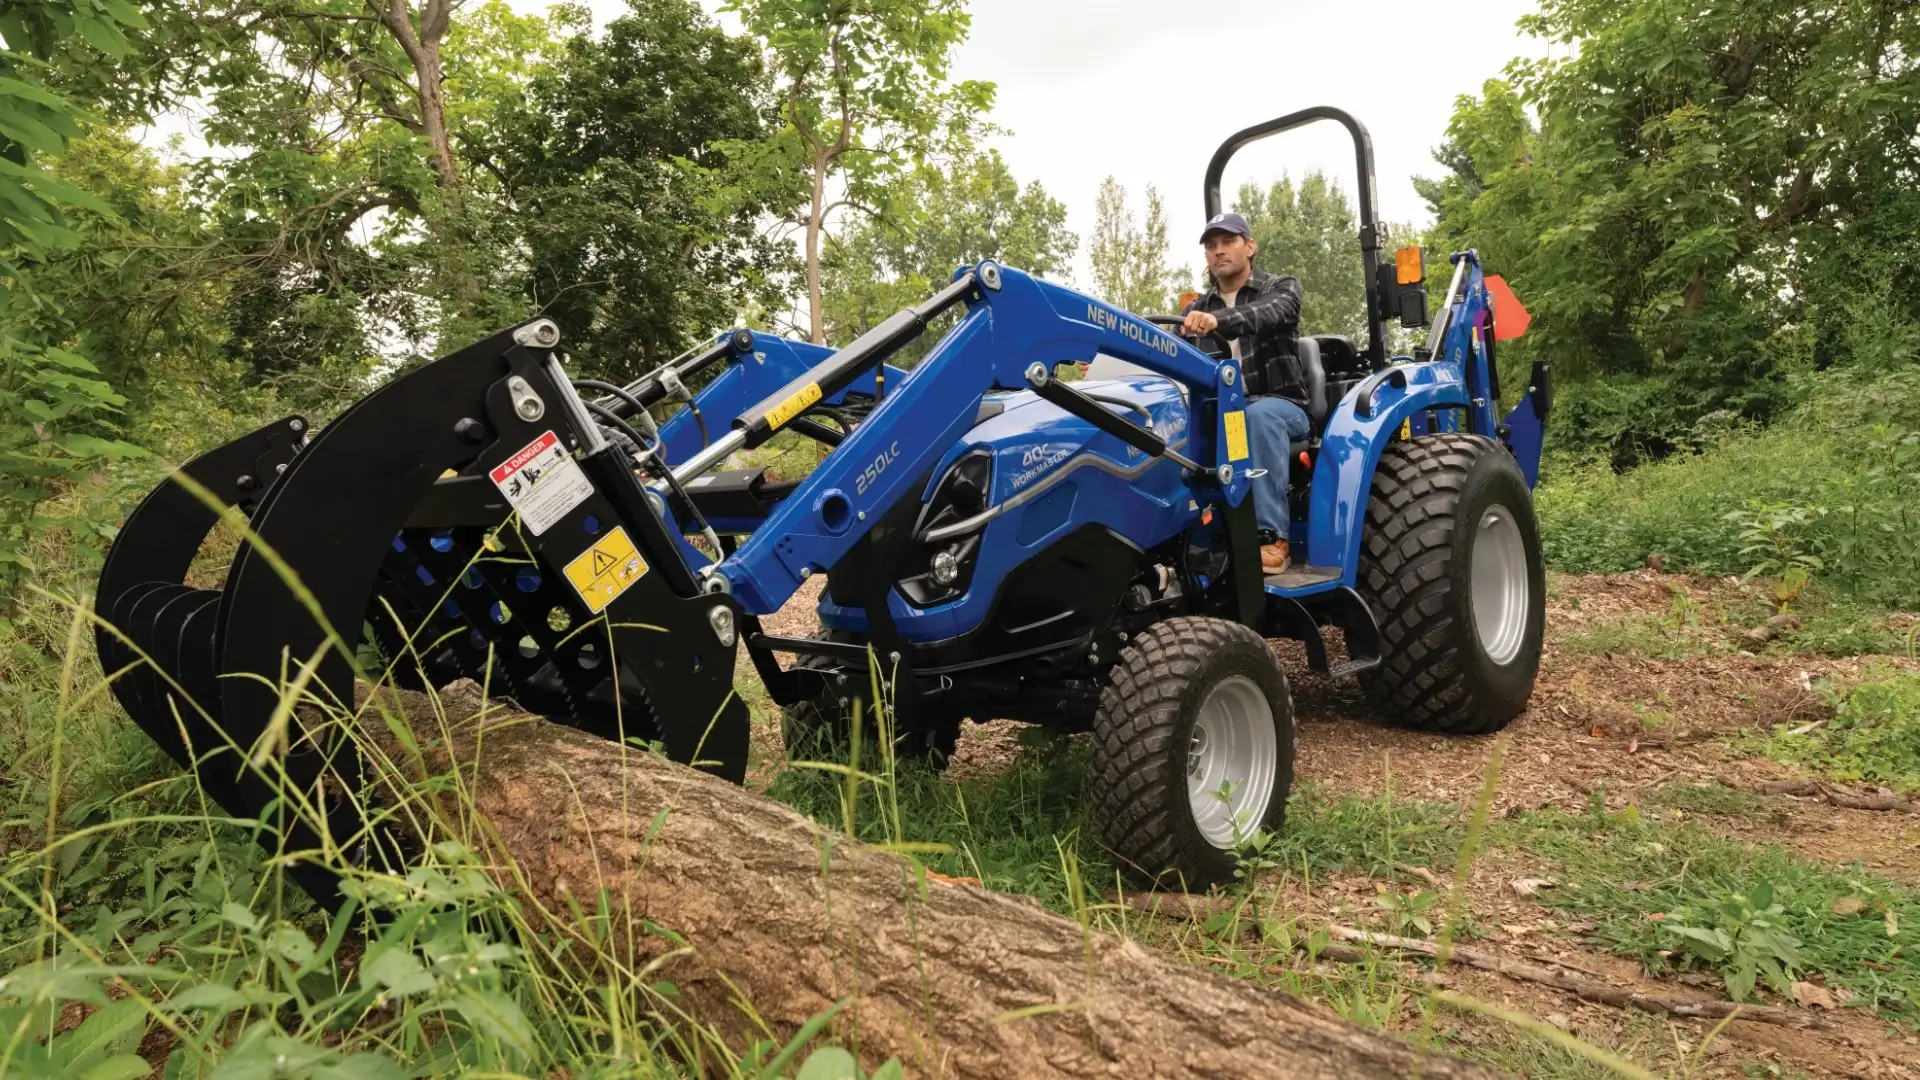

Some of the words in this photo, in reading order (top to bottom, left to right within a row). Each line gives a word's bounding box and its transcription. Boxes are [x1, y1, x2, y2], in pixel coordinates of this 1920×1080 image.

[1087, 303, 1117, 330] NEW
[1119, 318, 1178, 357] HOLLAND
[511, 440, 546, 468] DANGER
[855, 440, 900, 496] 250LC
[1012, 448, 1069, 488] WORKMASTER
